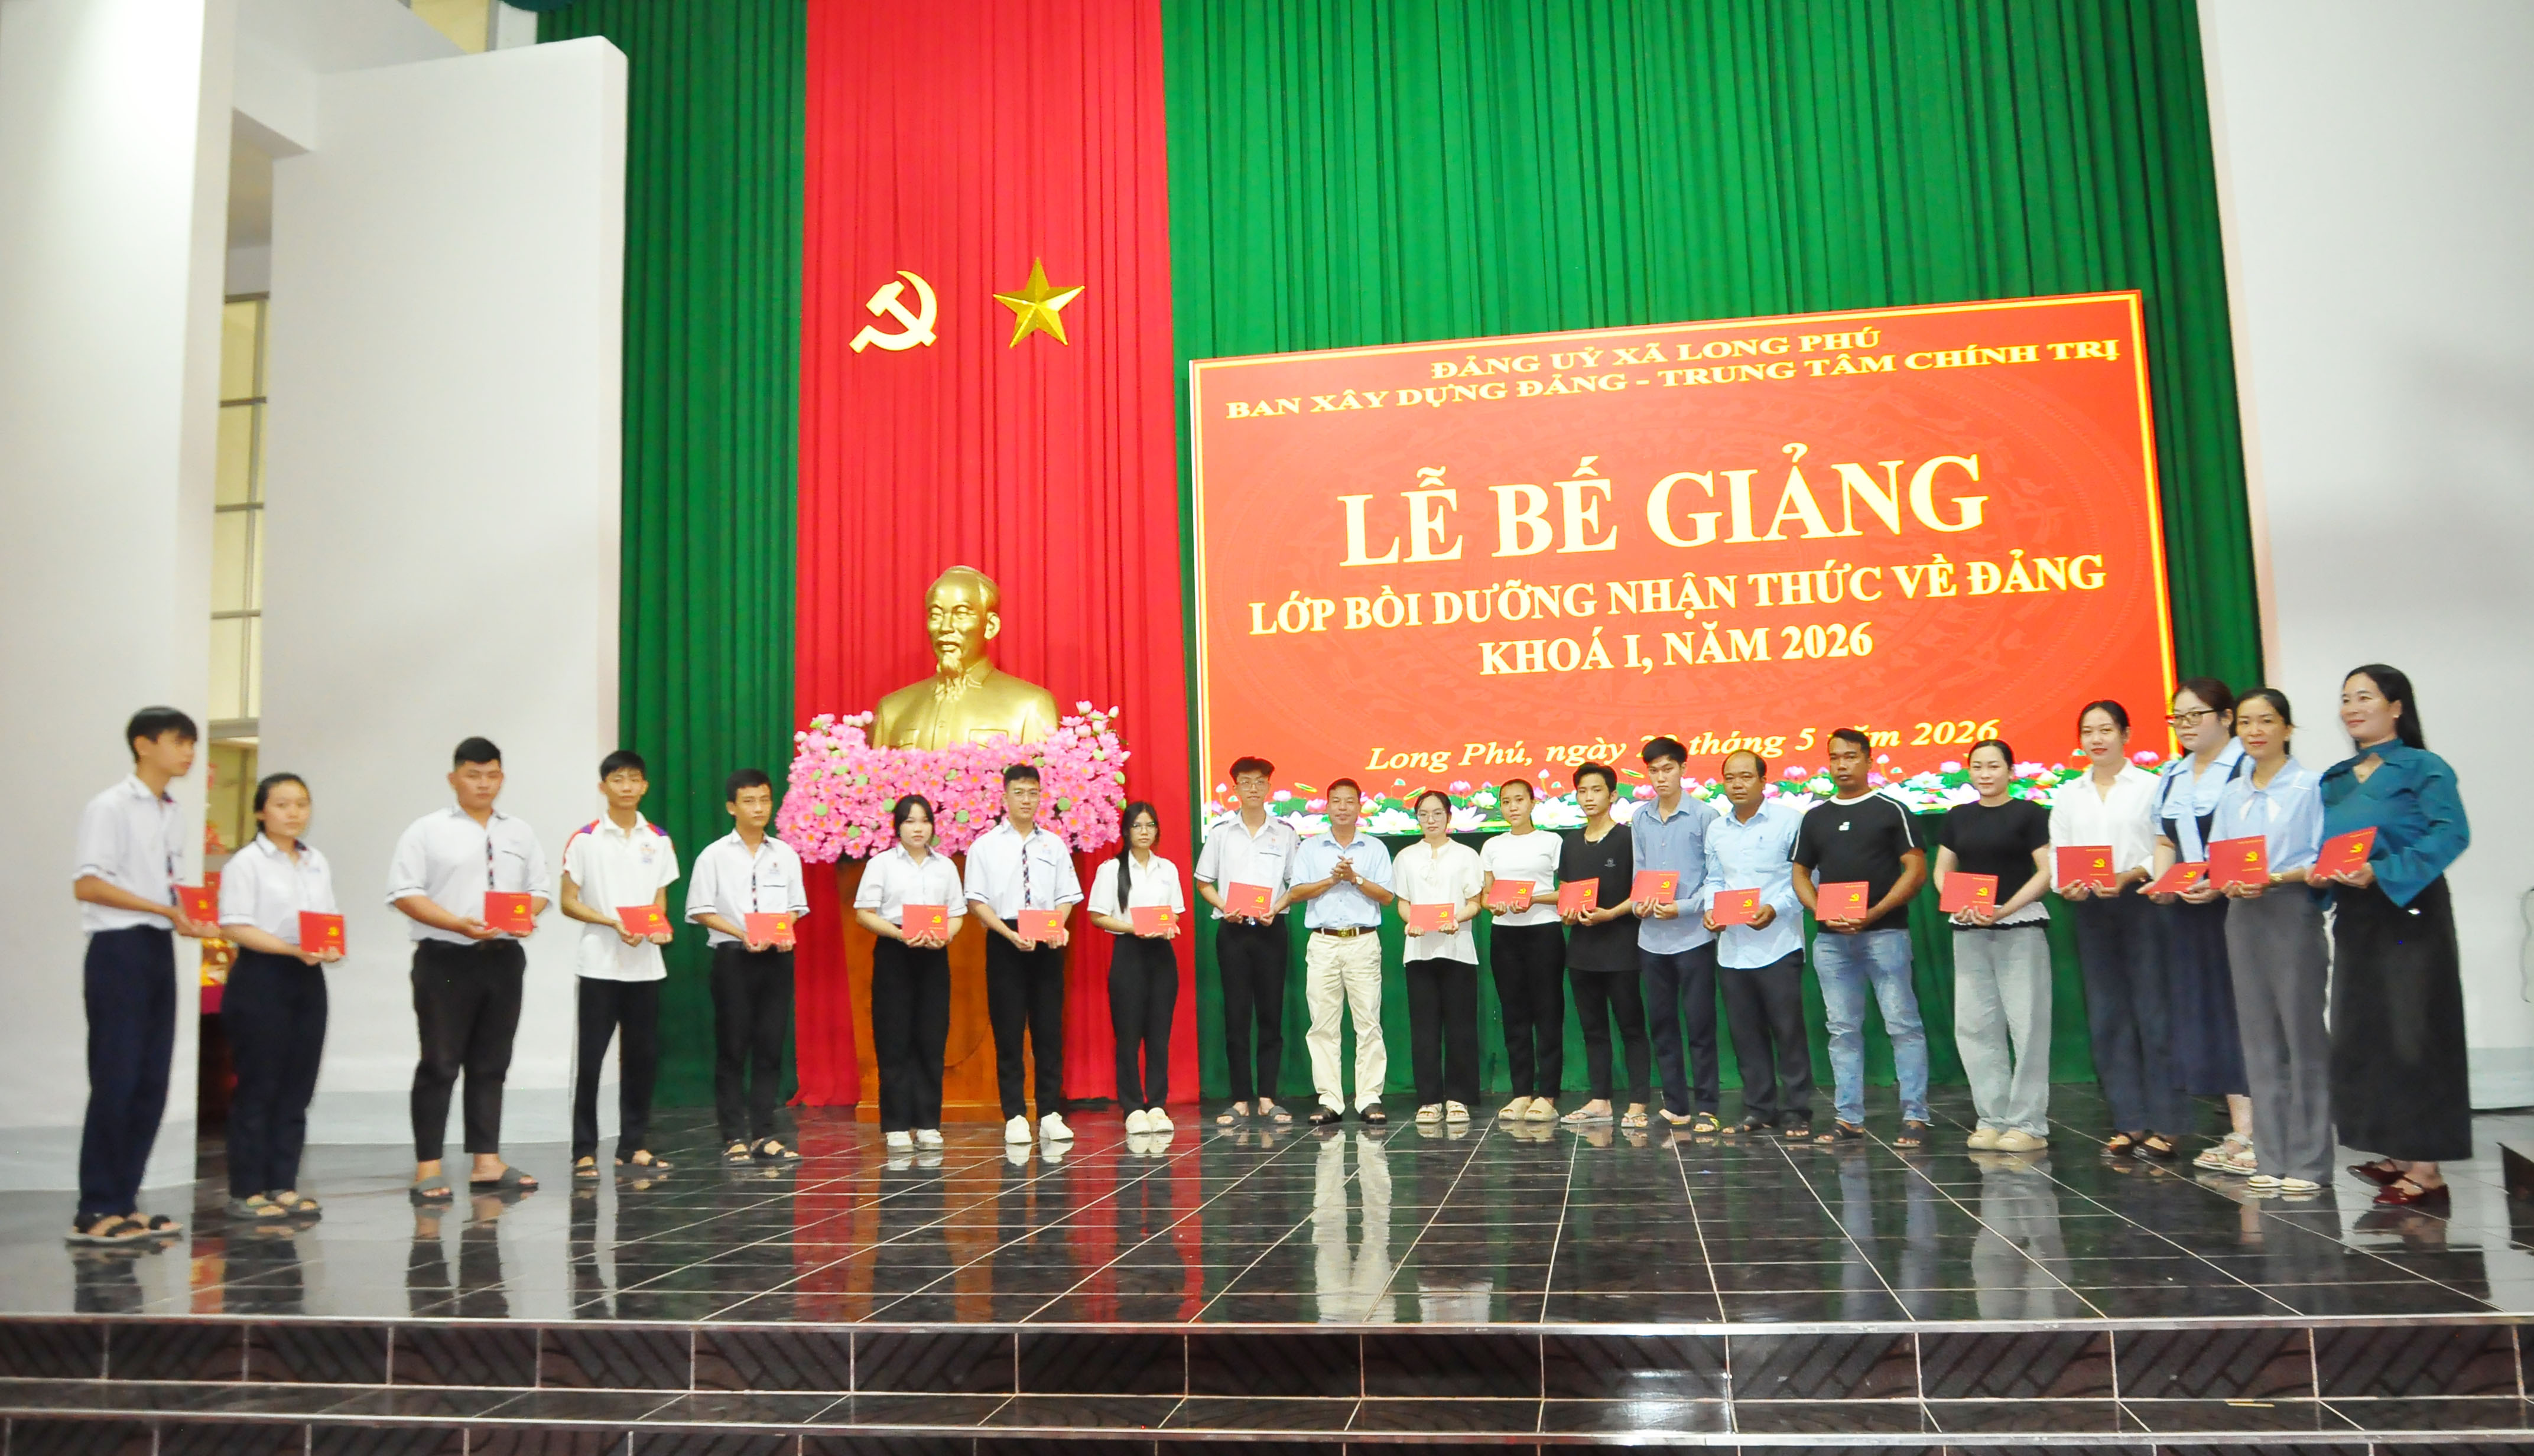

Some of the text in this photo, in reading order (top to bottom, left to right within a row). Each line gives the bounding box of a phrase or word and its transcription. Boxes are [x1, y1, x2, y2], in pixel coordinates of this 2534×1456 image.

[1226, 397, 1302, 419] BAN
[1310, 389, 1389, 413] XÂY
[1395, 382, 1509, 408] DỰNG
[1515, 373, 1629, 398] ĐẢNG
[1657, 362, 1798, 388] TRUNG
[1803, 352, 1898, 377] TÂM
[1904, 344, 2041, 370] CHÍNH
[2046, 339, 2120, 361] TRỊ
[1431, 326, 1882, 379] ĐẢNG UỶ XÃ LONG PHÚ
[1336, 442, 1989, 567] LỄ BẾ GIẢNG
[1247, 548, 2107, 636] LỚP BỒI DƯỠNG NHẬN THỨC VỀ ĐẢNG
[1477, 620, 1873, 675] KHOÁ I, NĂM 2026
[1365, 747, 1452, 774] Long
[1457, 740, 1533, 766] Phú,
[1545, 736, 1627, 767] ngày
[1688, 730, 1787, 759] tháng
[1794, 727, 1817, 751] 5
[1909, 719, 2000, 746] 2026
